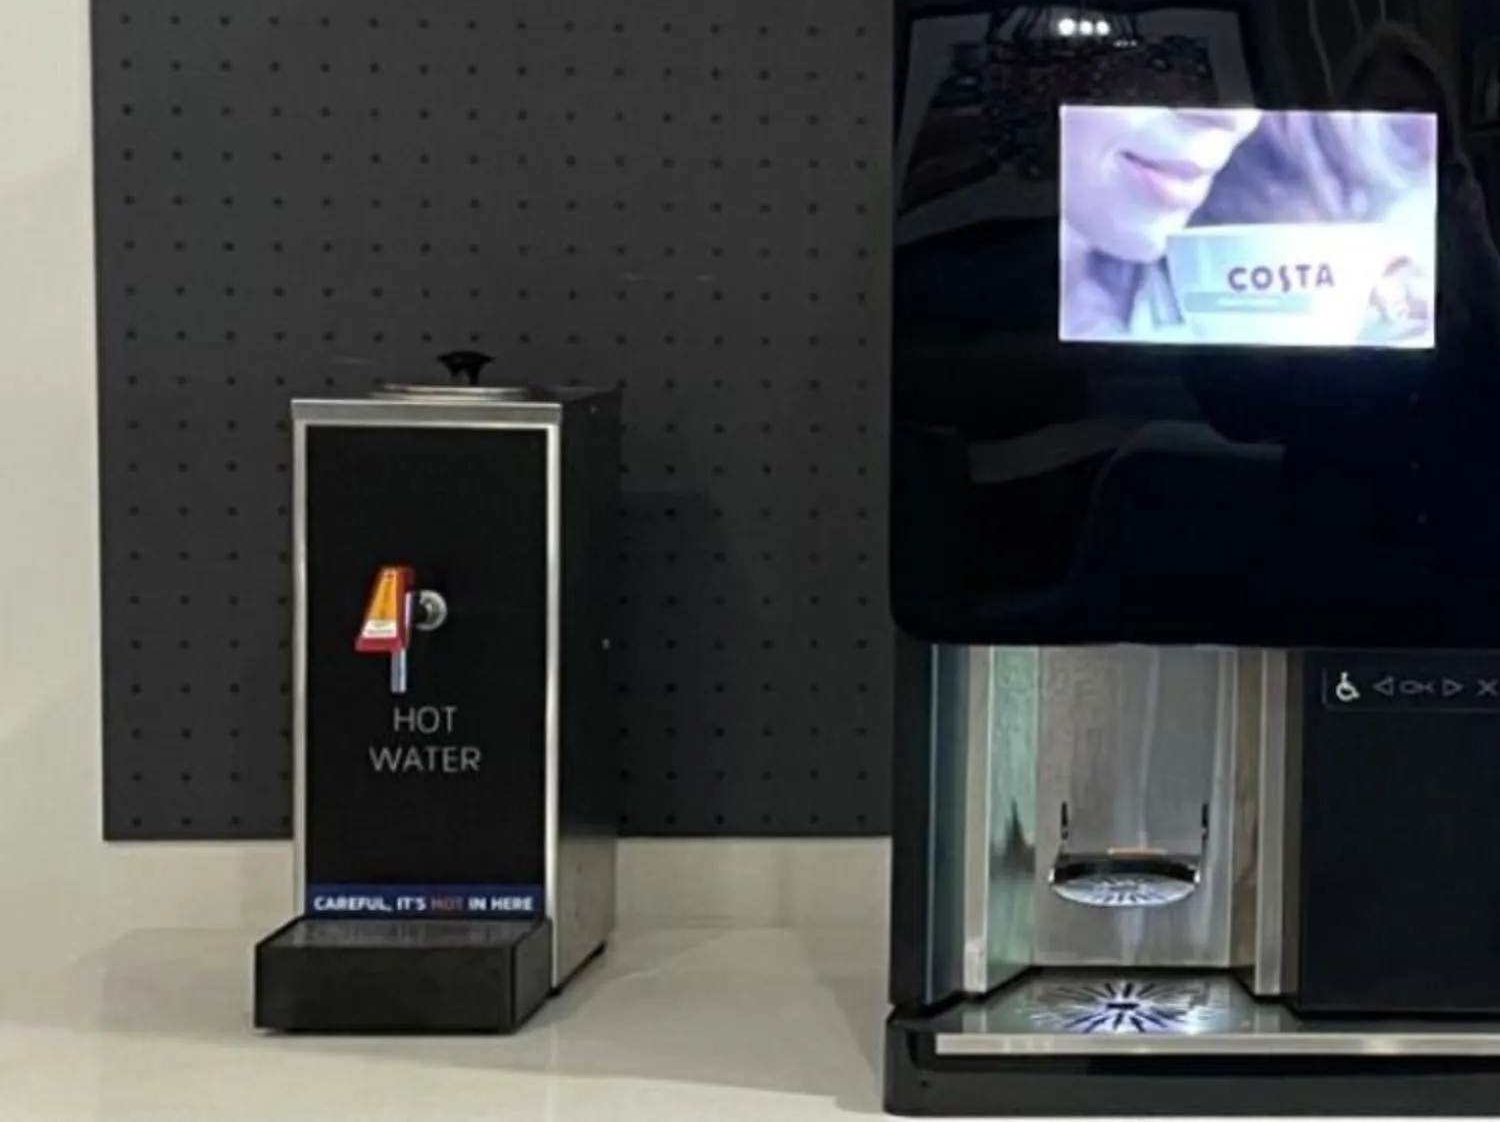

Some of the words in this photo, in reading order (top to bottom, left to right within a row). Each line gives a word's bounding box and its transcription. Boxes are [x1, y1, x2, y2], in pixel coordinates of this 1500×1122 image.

[1227, 263, 1335, 293] COSTA
[393, 705, 457, 733] HOT
[368, 745, 482, 772] WATER
[313, 895, 393, 912] CAREFUL,
[396, 896, 426, 911] IT'S
[431, 896, 463, 911] HOT
[468, 896, 486, 911] IN
[490, 896, 533, 911] HERE
